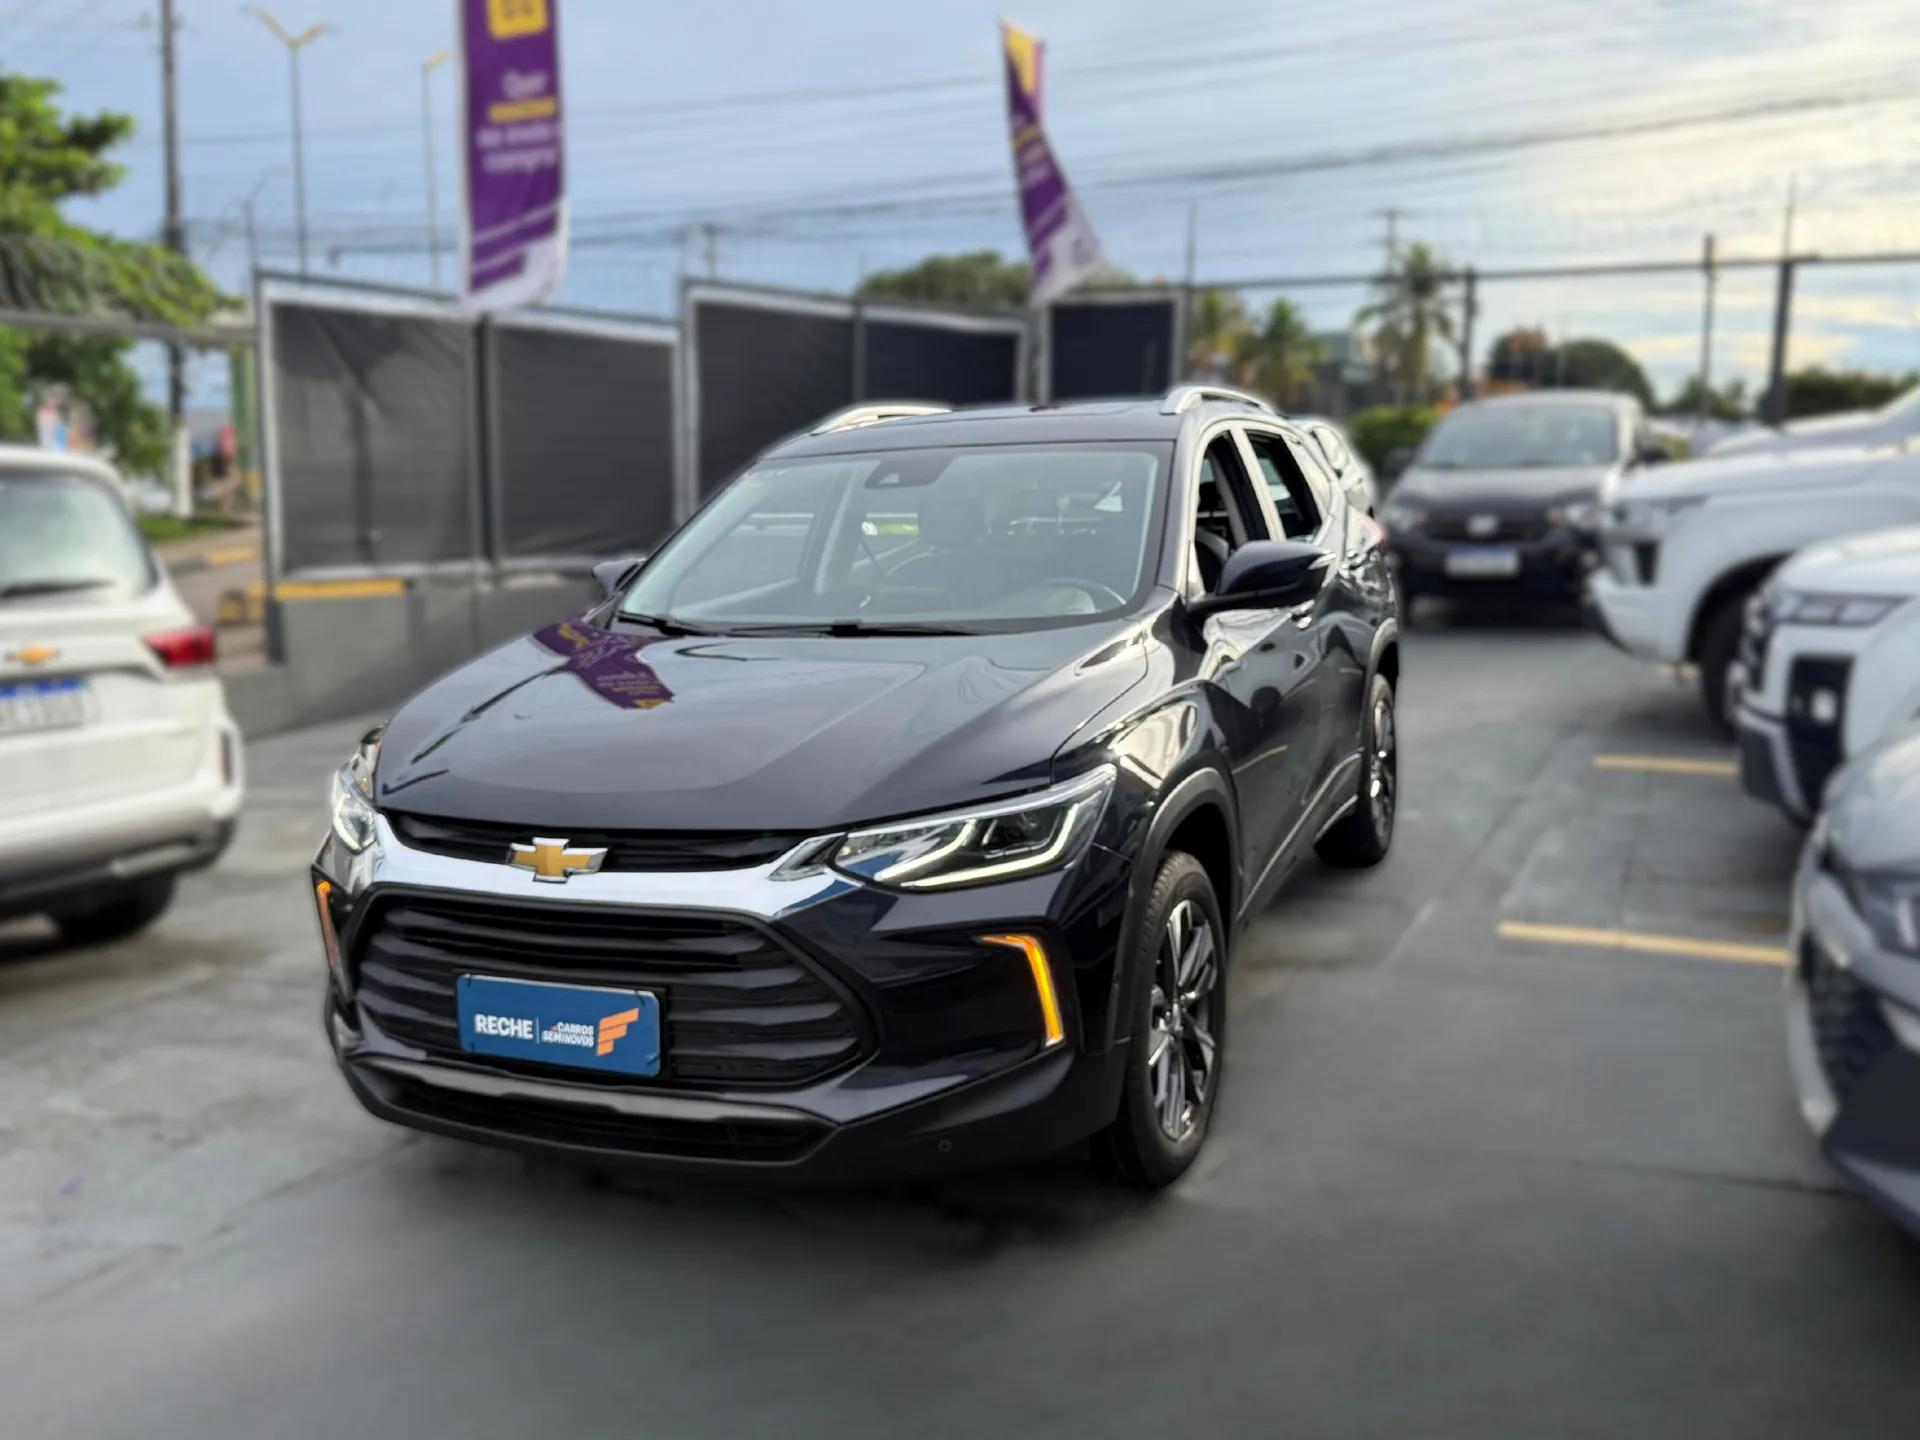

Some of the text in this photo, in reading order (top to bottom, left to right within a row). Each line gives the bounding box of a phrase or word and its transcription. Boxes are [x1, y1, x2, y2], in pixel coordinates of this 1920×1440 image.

[474, 1013, 534, 1040] RECHE
[556, 1021, 595, 1036] CARROS
[541, 1029, 595, 1048] SEMINOVOS
